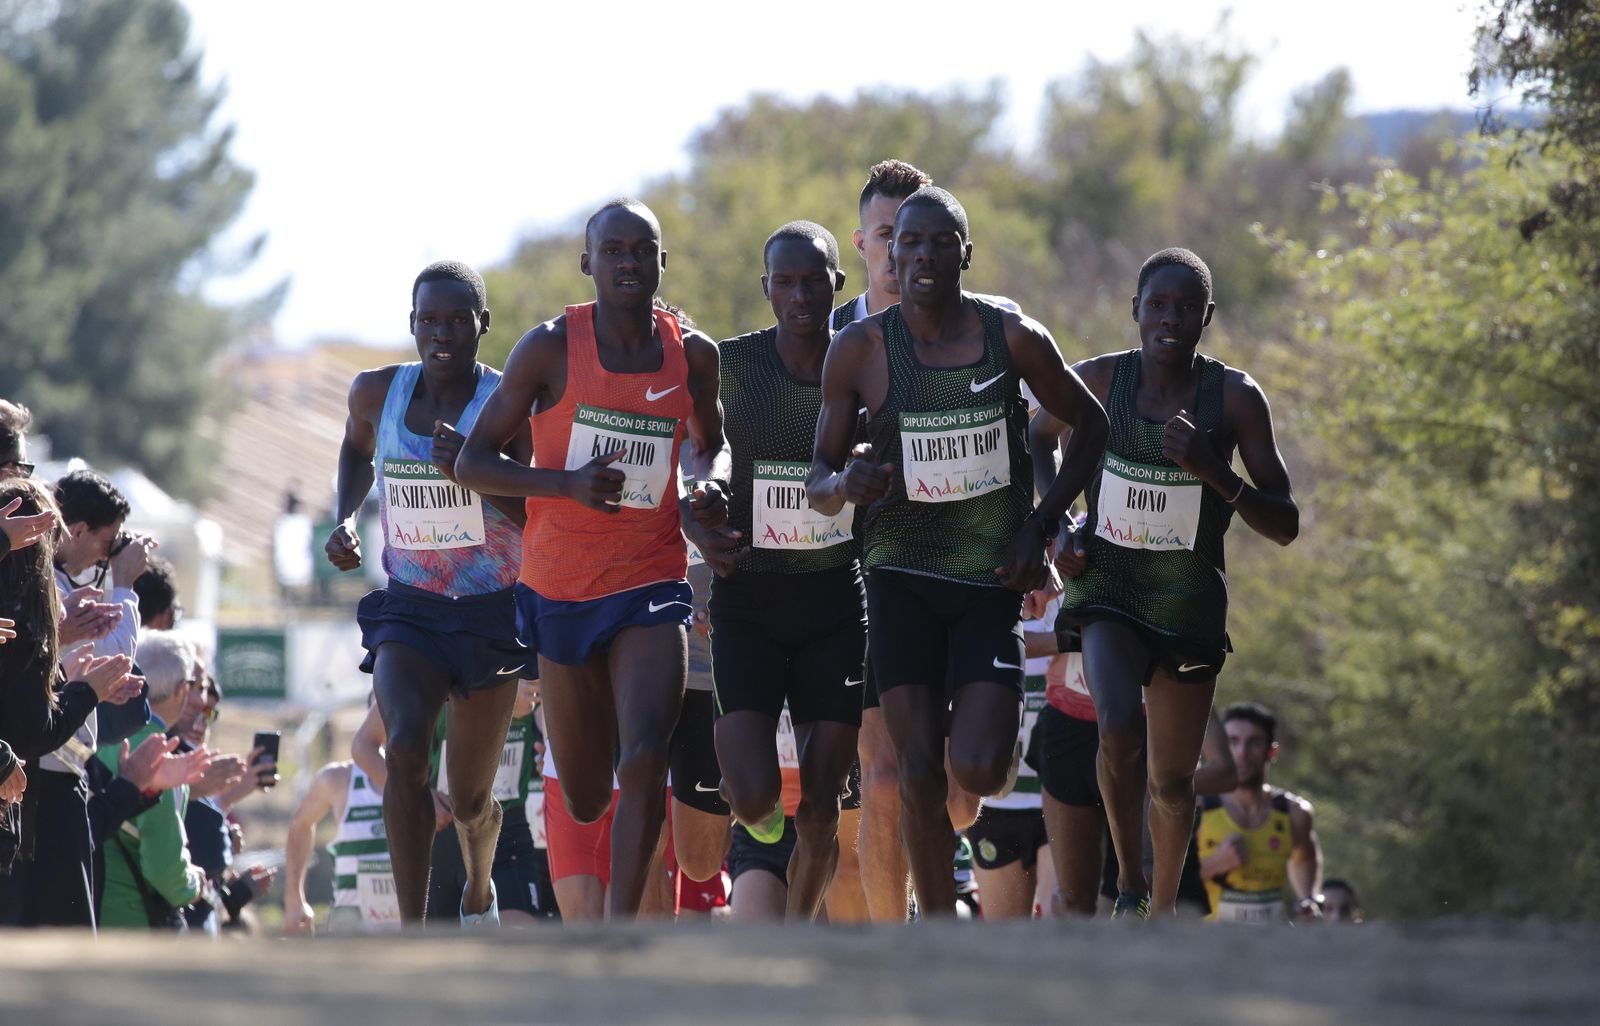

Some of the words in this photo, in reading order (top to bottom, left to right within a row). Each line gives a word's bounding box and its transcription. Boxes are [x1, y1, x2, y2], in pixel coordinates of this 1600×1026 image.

[579, 409, 633, 430] DIPUTACION
[635, 419, 645, 430] DE
[647, 420, 674, 433] SEVILLA
[903, 415, 957, 428] DIPUTACION
[959, 413, 971, 424] DE
[973, 406, 1003, 422] SEVILLA
[911, 434, 969, 462] ALBERT
[973, 427, 1001, 456] ROP
[428, 464, 439, 475] DE
[1107, 457, 1152, 480] DIPUTACION
[1154, 470, 1166, 481] DE
[389, 483, 472, 509] BUSHENDICH
[915, 469, 1003, 499] Andalucía
[1126, 486, 1167, 513] RONO
[394, 522, 476, 546] Andalucía
[761, 521, 844, 546] Andalucía
[1103, 516, 1186, 546] Andalucía
